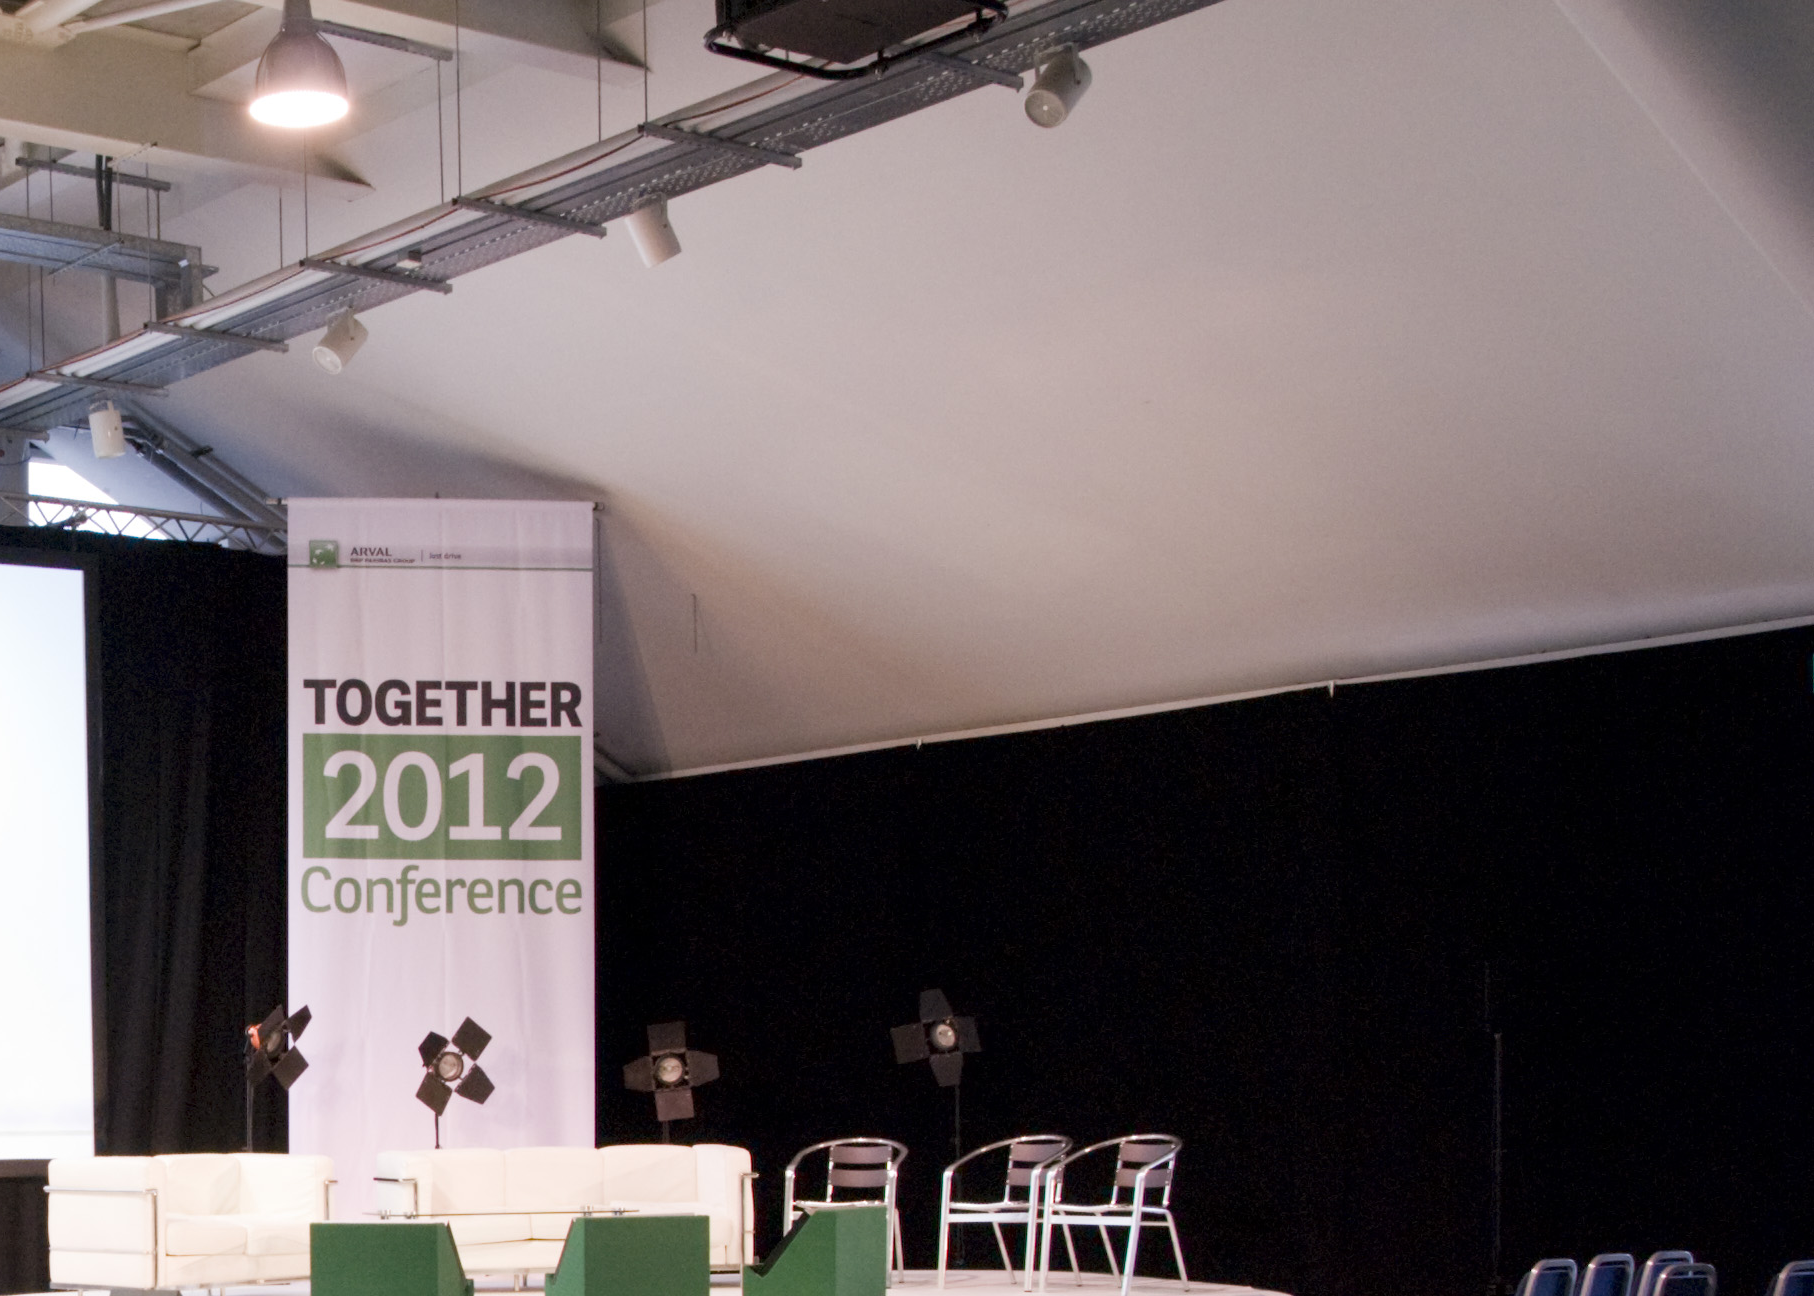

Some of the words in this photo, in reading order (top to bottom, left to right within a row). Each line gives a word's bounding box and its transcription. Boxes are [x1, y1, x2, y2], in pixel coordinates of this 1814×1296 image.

[350, 547, 392, 557] ARVAL
[303, 679, 582, 727] TOGETHER
[322, 750, 562, 841] 2012
[301, 865, 582, 927] Conference
